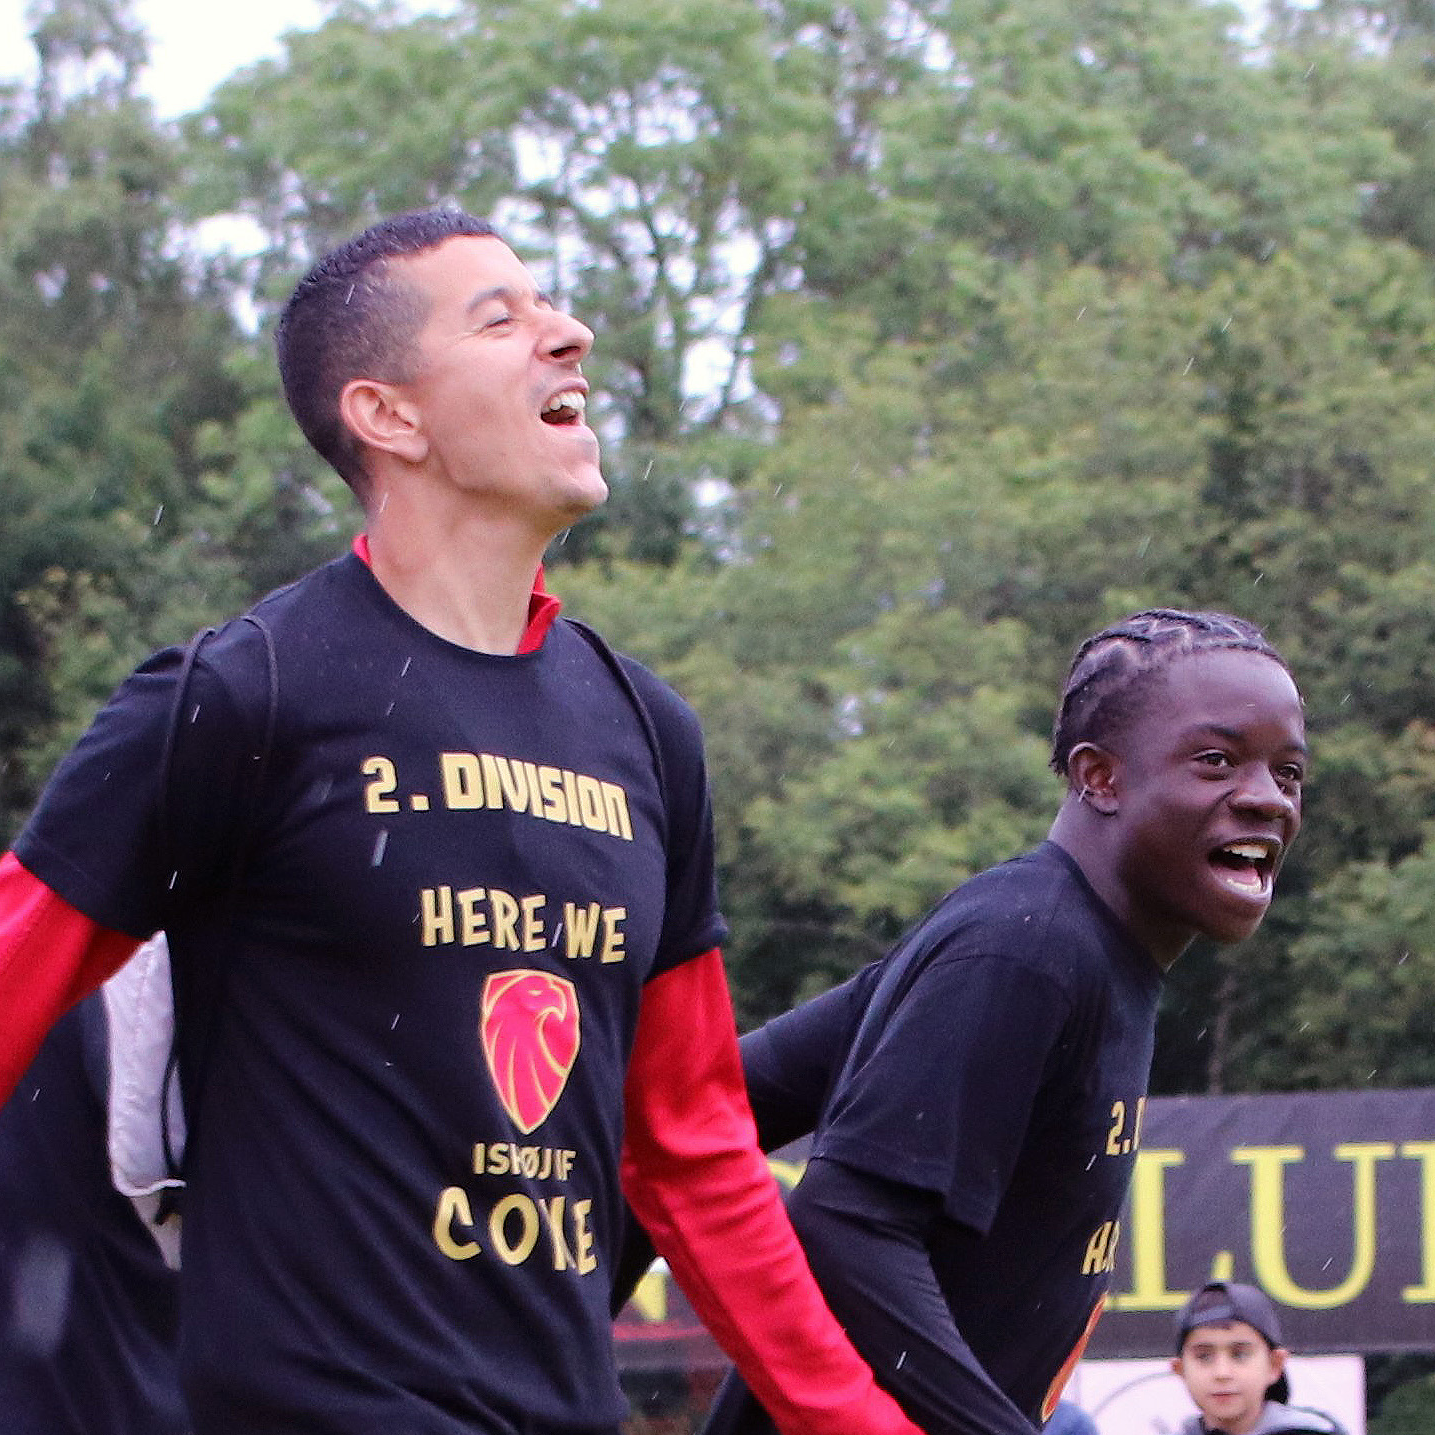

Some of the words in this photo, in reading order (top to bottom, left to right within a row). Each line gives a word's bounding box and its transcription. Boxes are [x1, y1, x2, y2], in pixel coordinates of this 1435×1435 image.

[362, 755, 431, 814] 2.
[441, 752, 634, 841] DIVISION
[420, 885, 548, 952] HERE
[565, 901, 627, 963] WE
